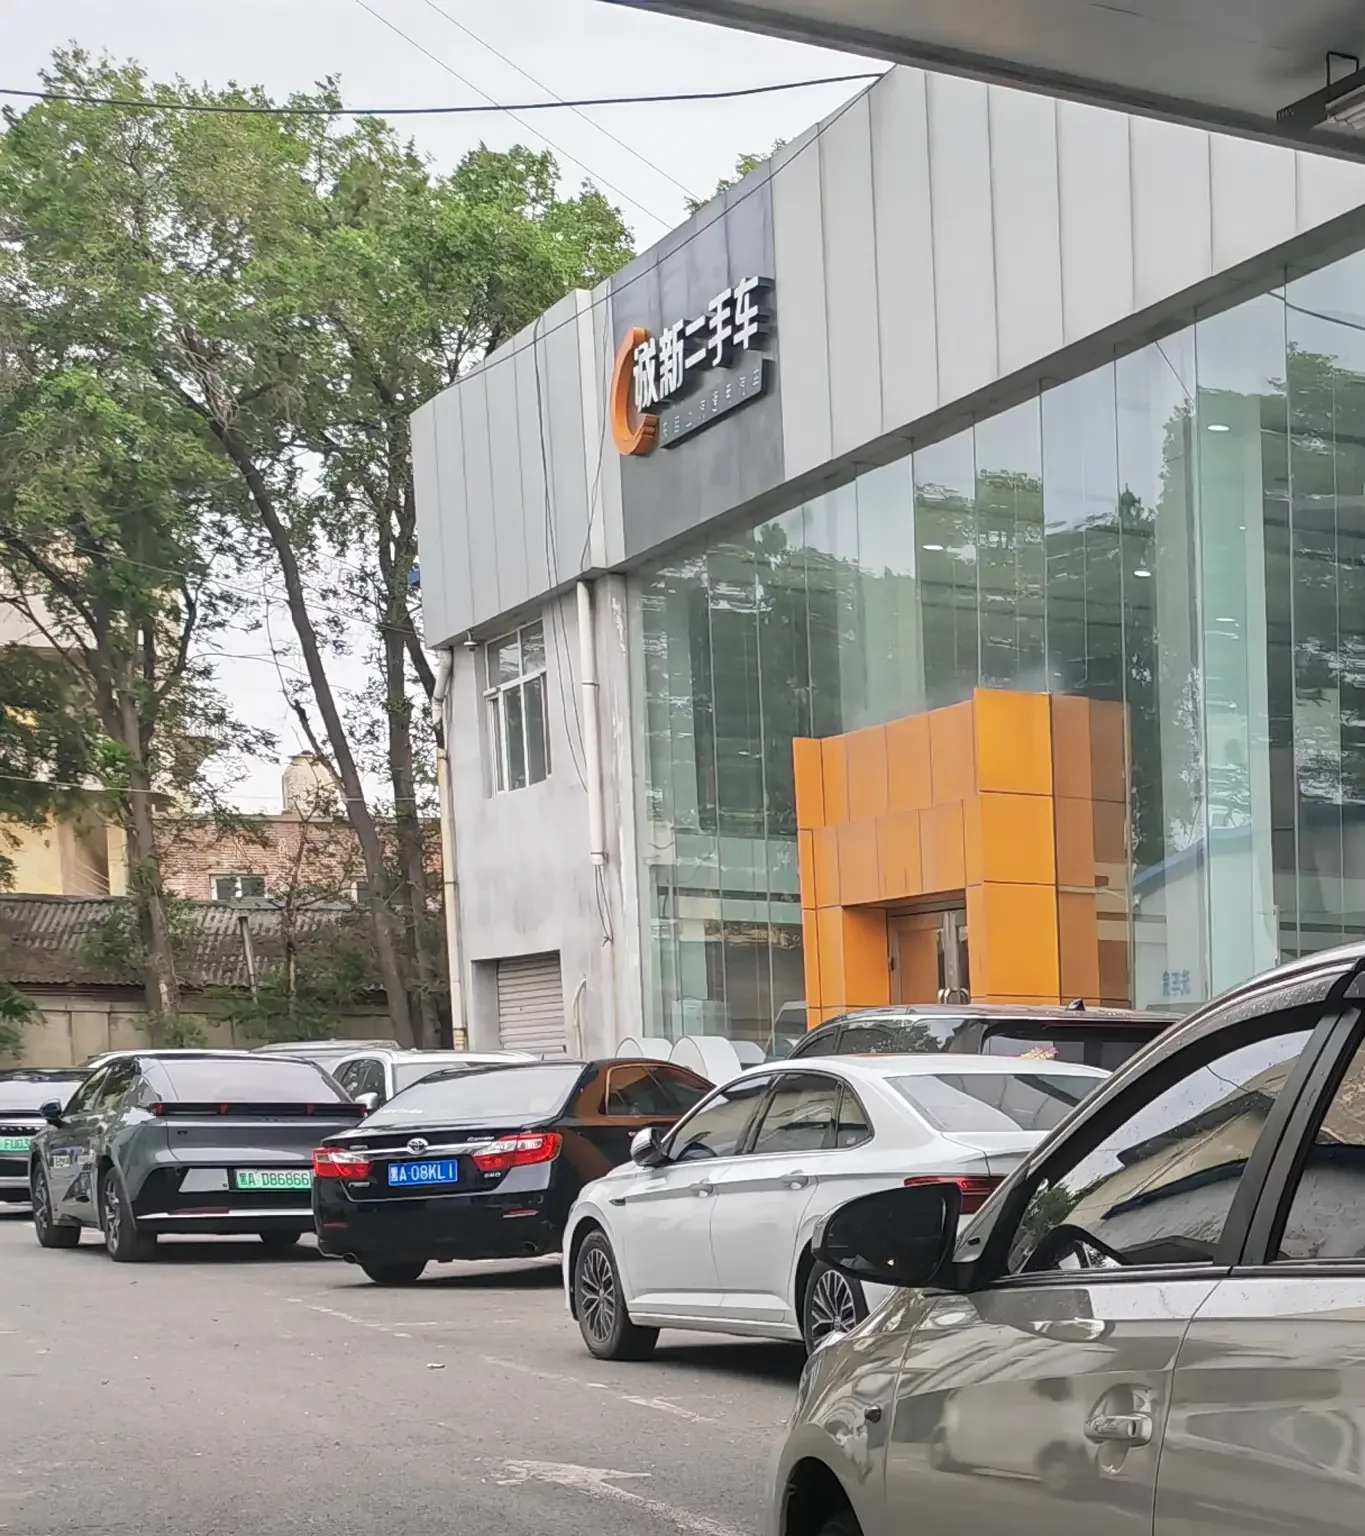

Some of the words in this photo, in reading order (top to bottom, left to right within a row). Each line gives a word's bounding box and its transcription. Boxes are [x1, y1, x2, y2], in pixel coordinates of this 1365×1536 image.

[633, 276, 759, 413] 诚新二手车
